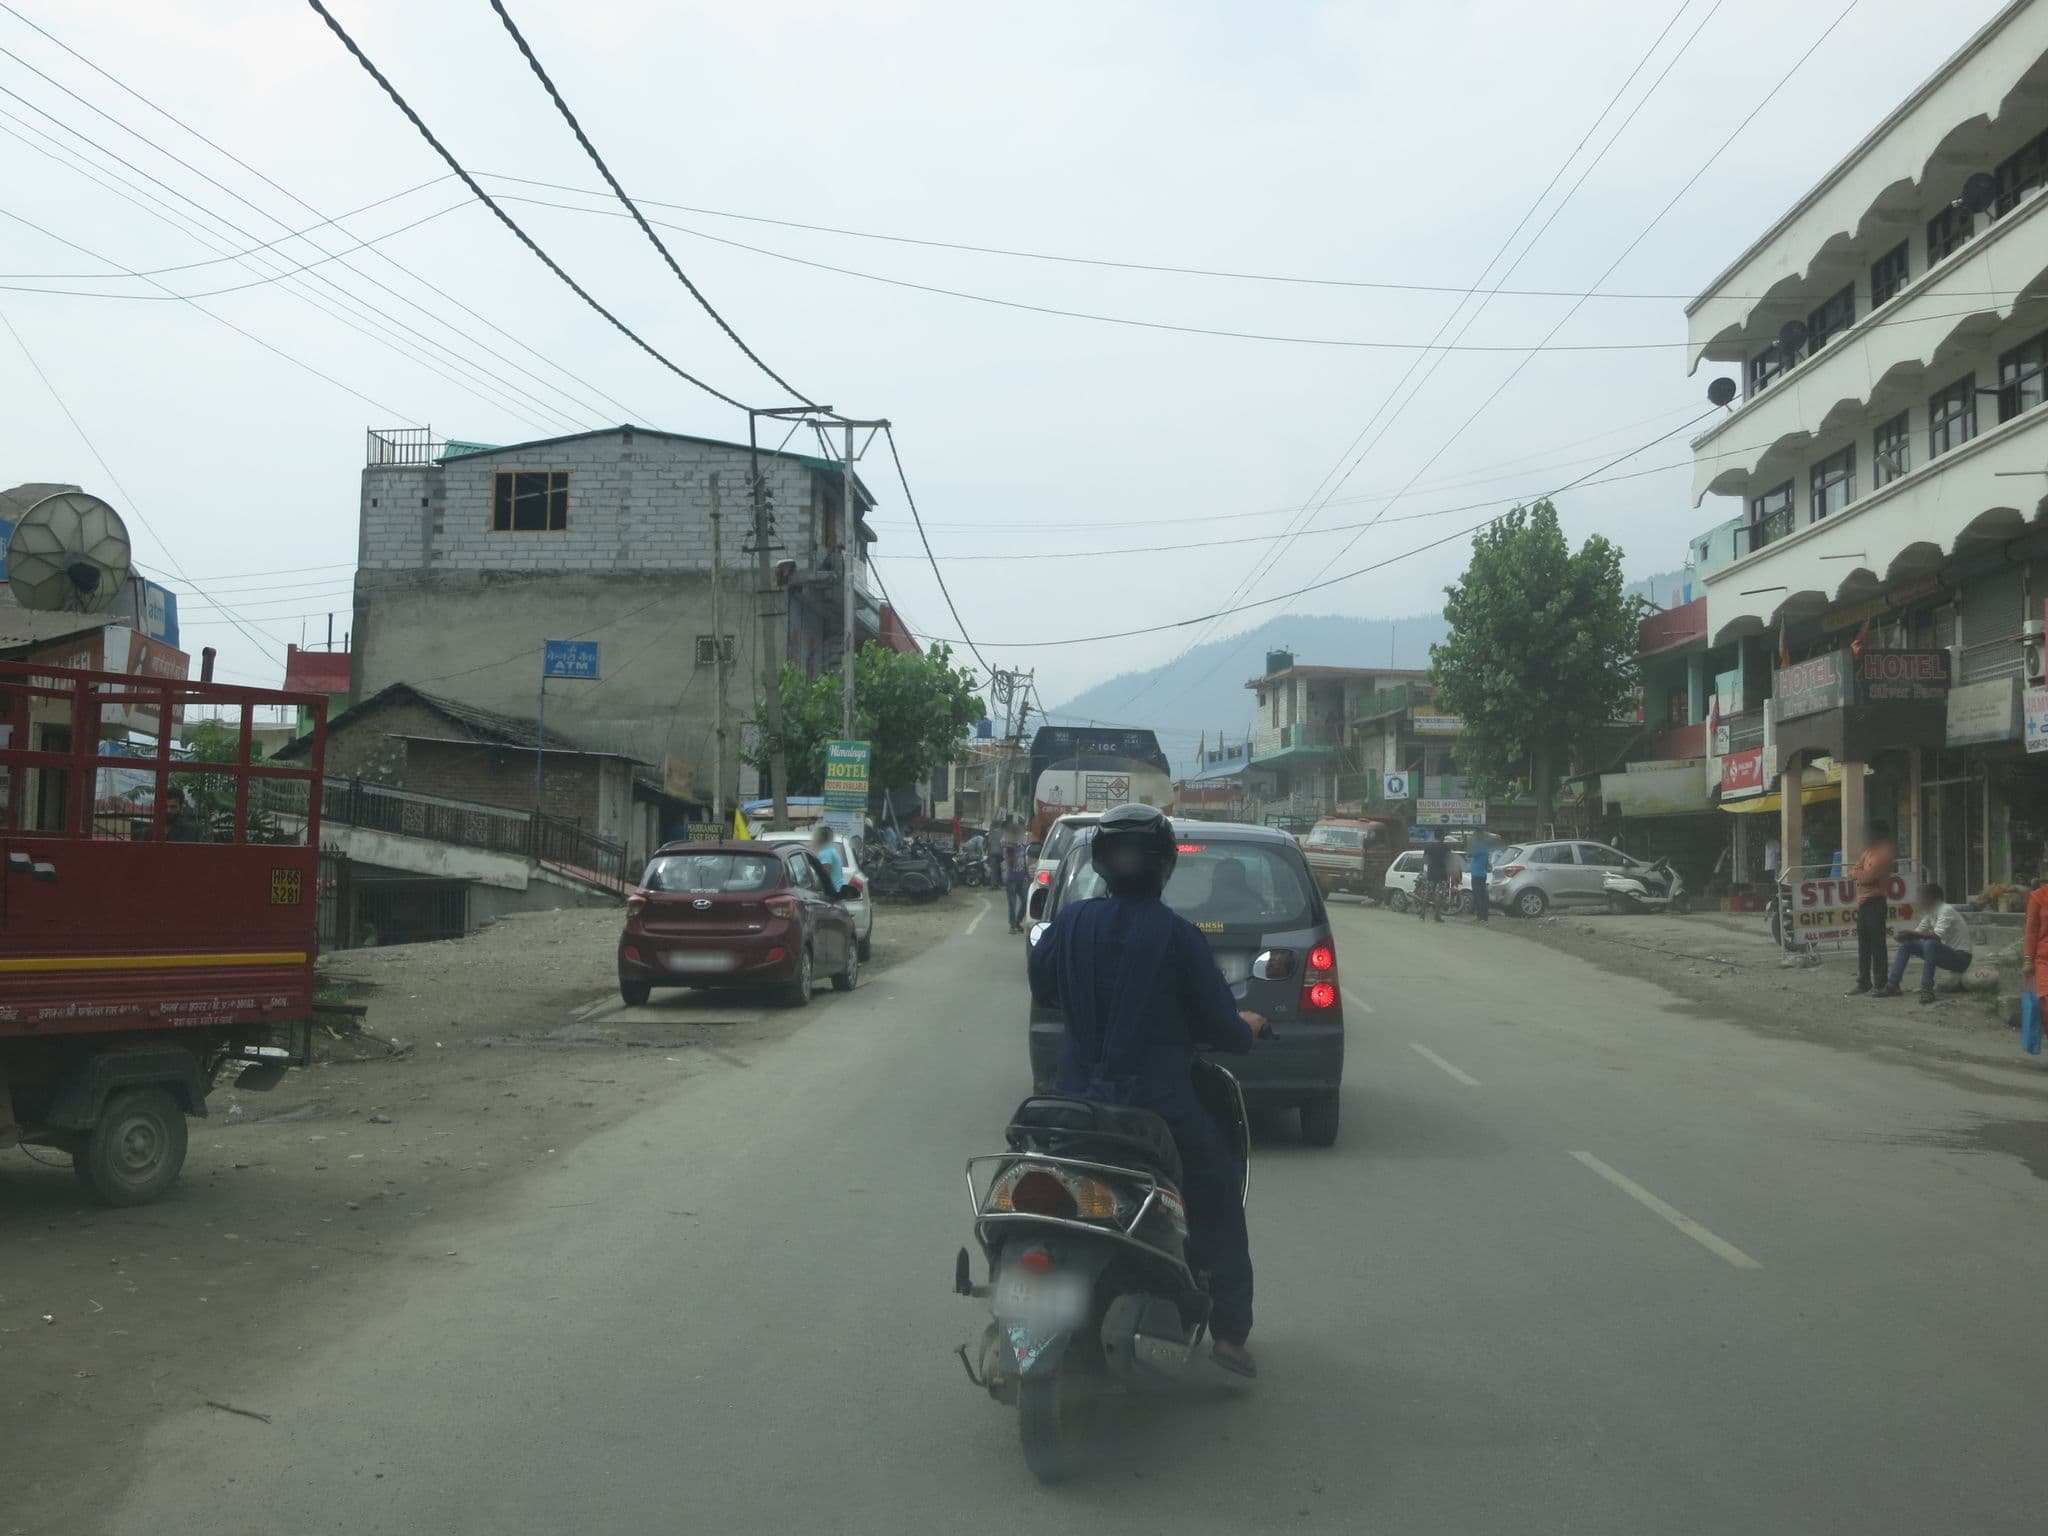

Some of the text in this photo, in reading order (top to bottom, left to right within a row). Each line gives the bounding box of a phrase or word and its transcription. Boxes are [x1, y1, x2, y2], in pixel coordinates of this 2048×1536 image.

[149, 604, 164, 620] atm
[555, 660, 588, 670] ATM
[1865, 655, 1947, 680] HOTEL
[1780, 656, 1835, 698] HOTEL
[827, 763, 867, 778] HOTEL
[1801, 876, 1906, 906] STUO
[1800, 911, 1835, 926] GIFT
